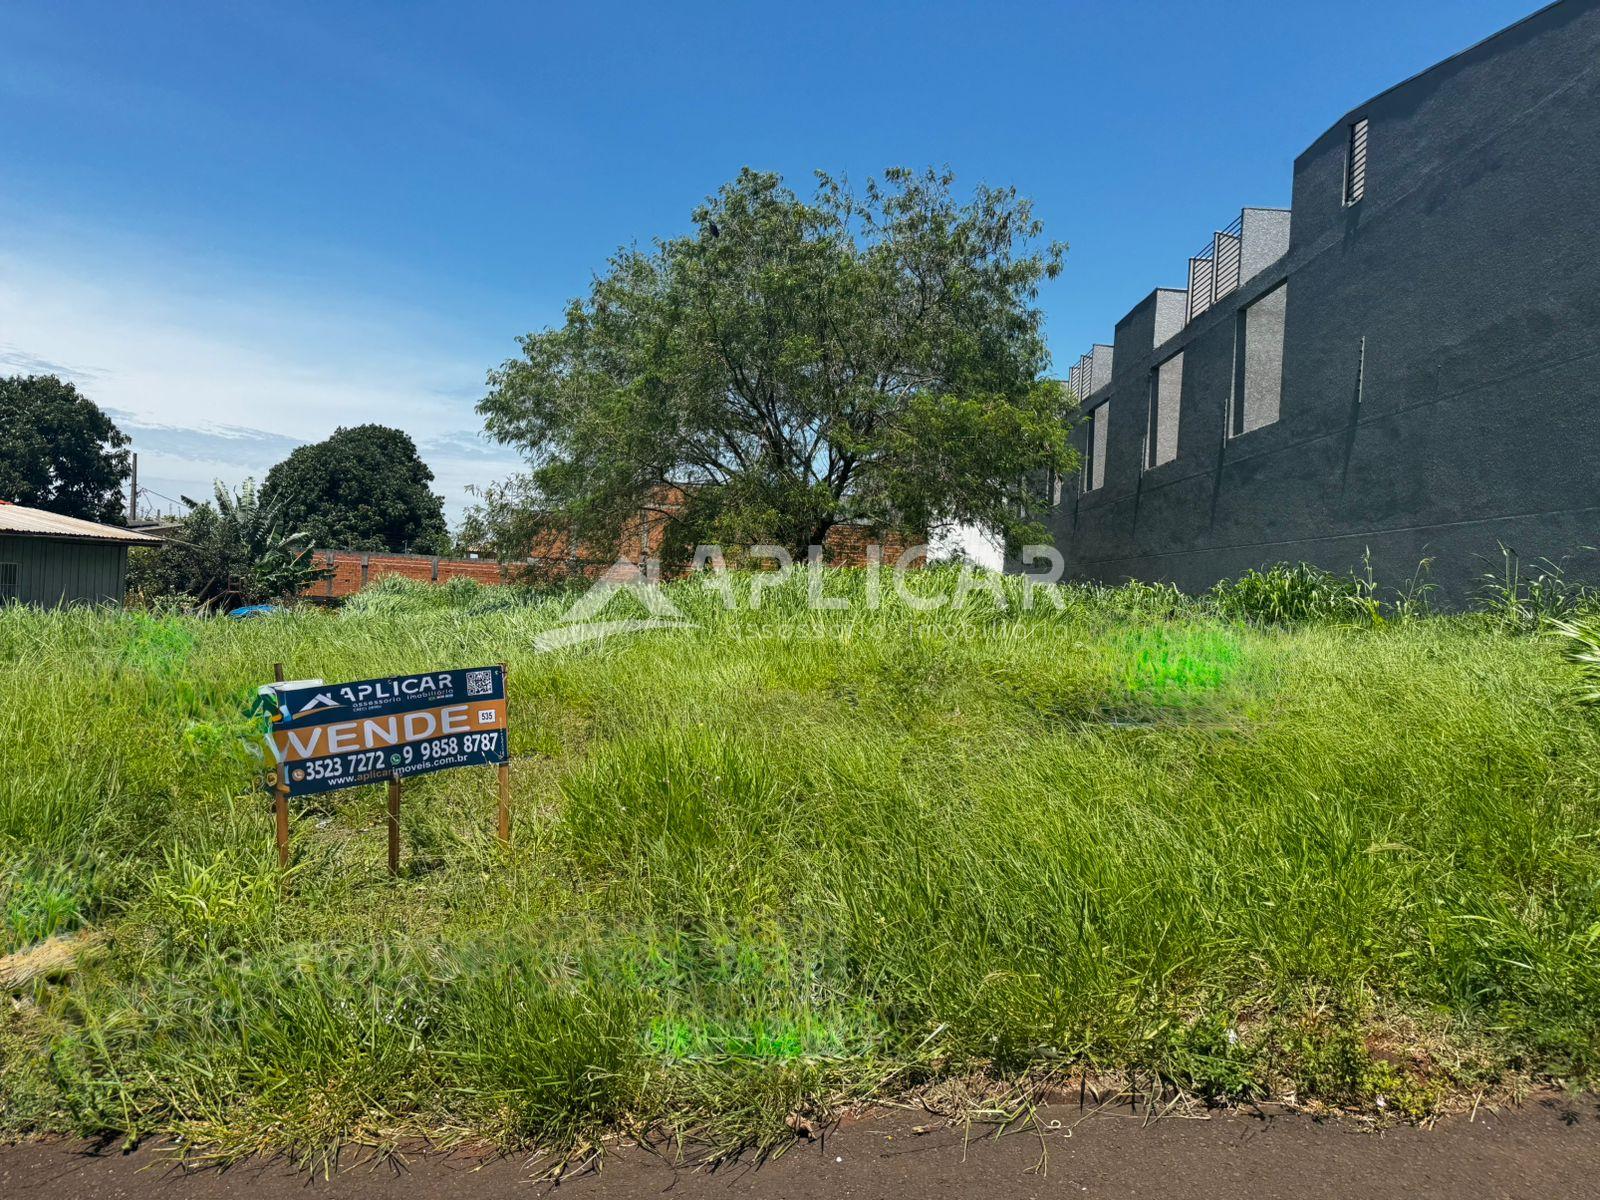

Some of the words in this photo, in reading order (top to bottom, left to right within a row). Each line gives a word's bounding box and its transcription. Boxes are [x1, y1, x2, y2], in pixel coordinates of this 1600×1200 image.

[340, 674, 452, 701] APLICAR
[352, 697, 401, 709] assessoria
[481, 712, 493, 720] 535
[288, 705, 471, 758] VENDE
[306, 758, 342, 780] 3523
[348, 751, 385, 774] 7272
[403, 746, 413, 764] 9
[421, 737, 458, 760] 9858
[463, 732, 498, 752] 8787
[328, 754, 468, 785] www.aplicarimoveis.com.br
